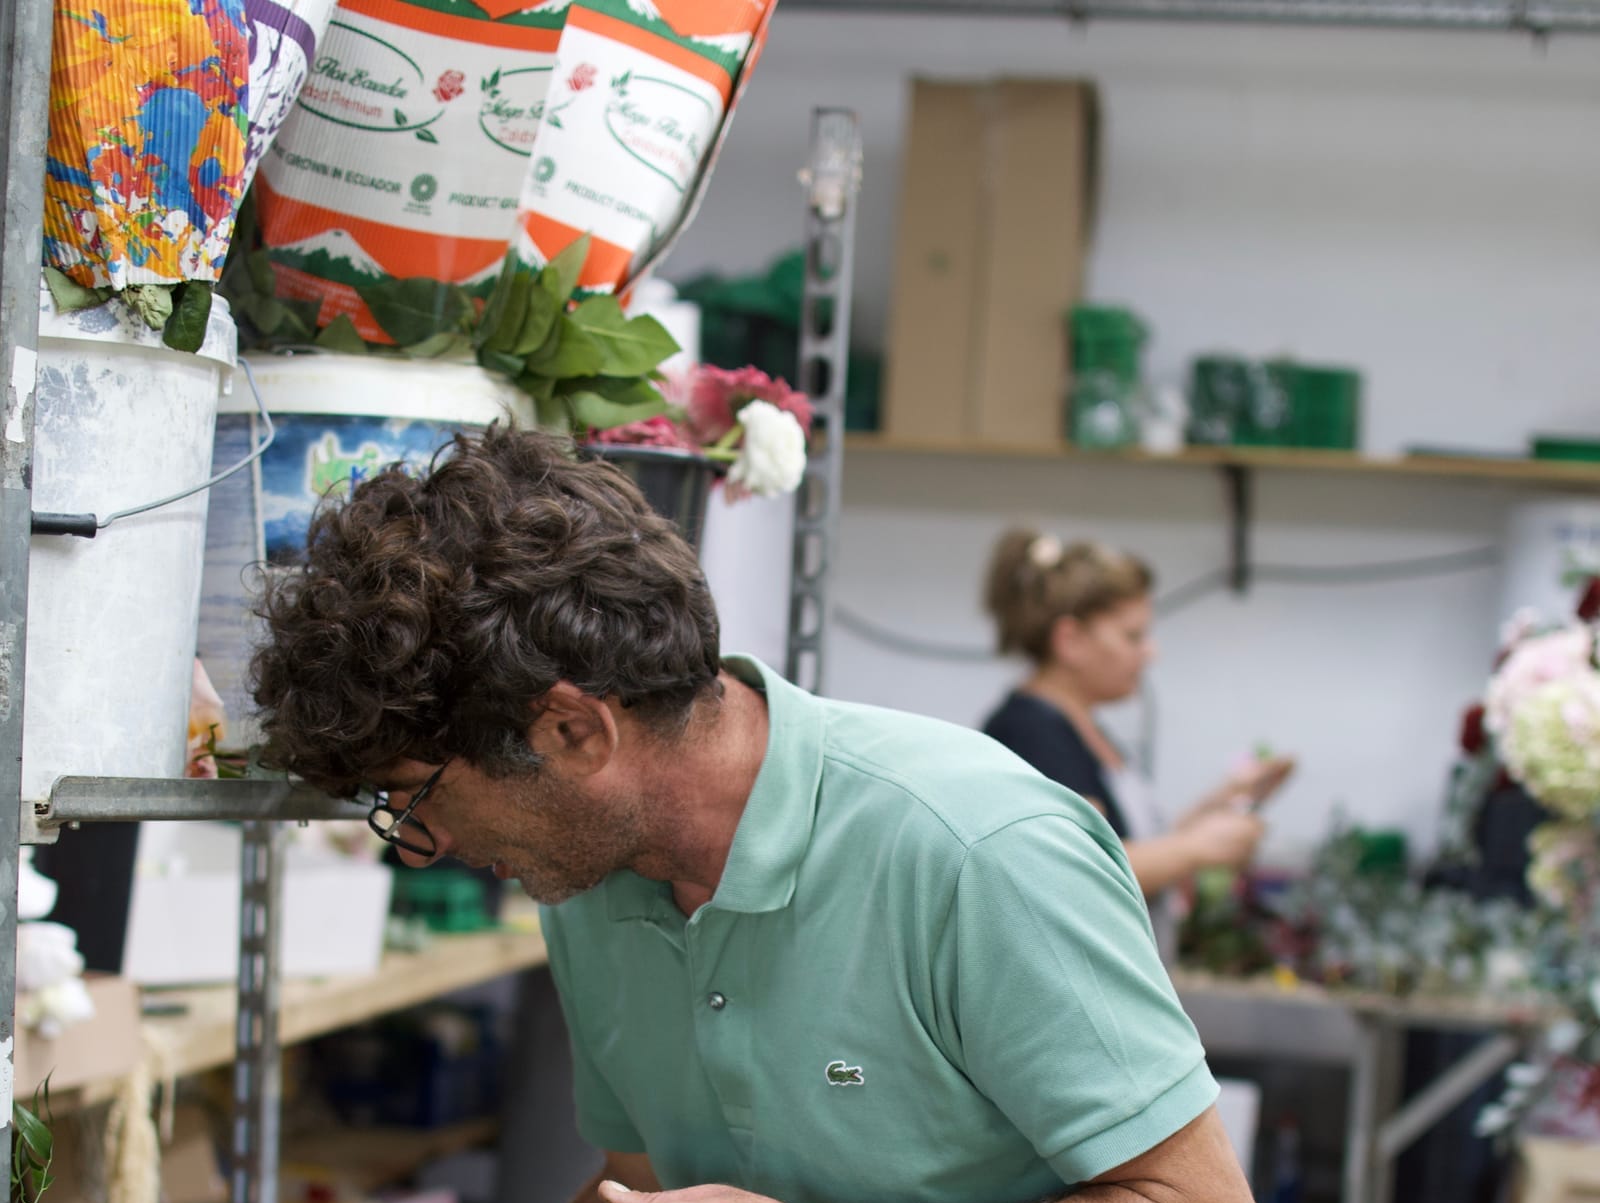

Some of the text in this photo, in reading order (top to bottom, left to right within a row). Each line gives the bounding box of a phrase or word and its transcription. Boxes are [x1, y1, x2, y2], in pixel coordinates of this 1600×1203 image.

[348, 67, 408, 99] Ecuador
[331, 89, 384, 118] Premium
[285, 151, 403, 194] GROWN IN ECUADOR
[448, 192, 498, 209] PRODUCT
[564, 180, 615, 208] PRODUCT
